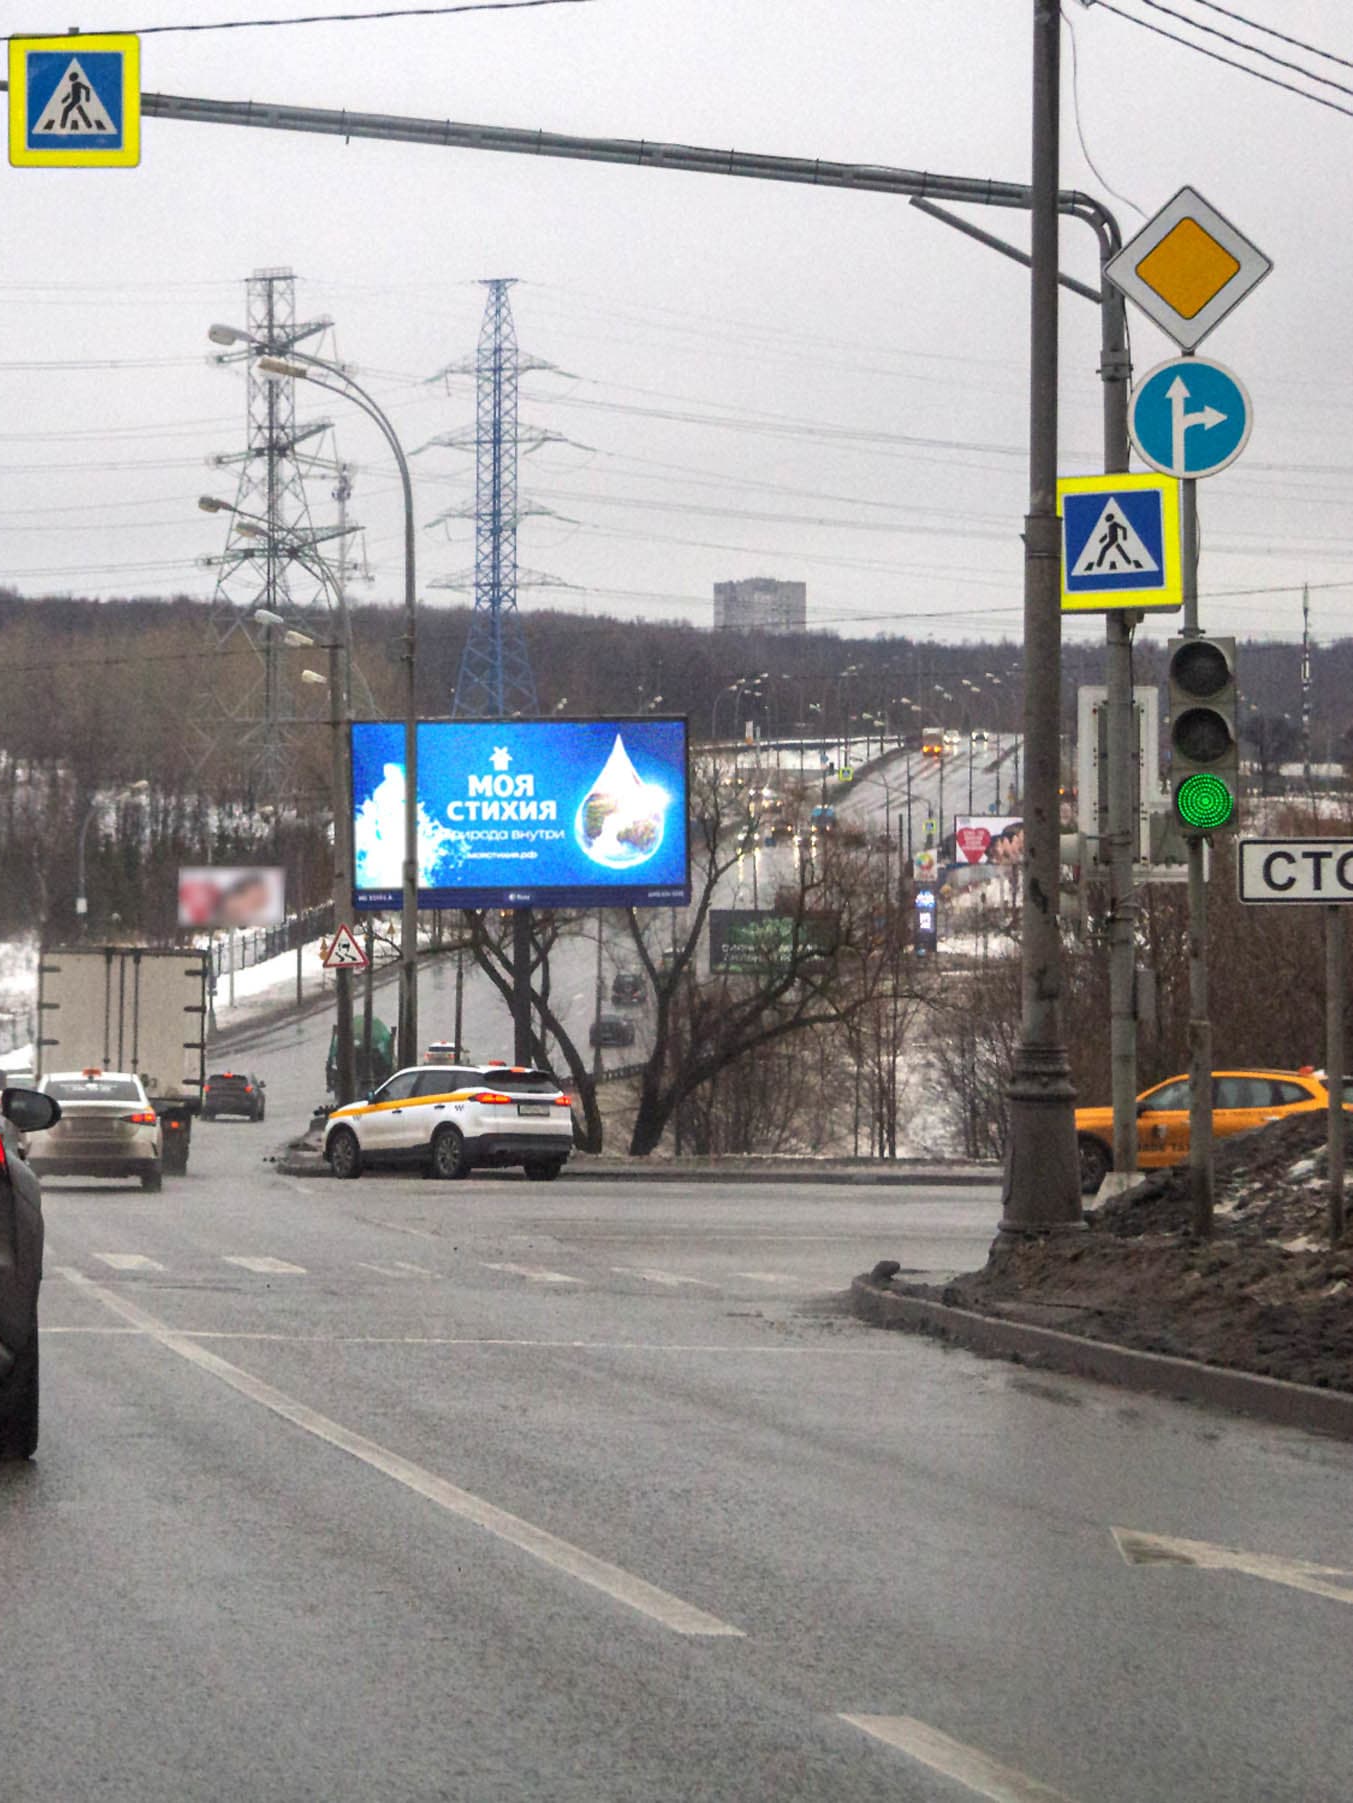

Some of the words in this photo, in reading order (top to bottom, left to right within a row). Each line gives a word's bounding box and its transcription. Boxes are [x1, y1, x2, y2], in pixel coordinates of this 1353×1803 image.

[468, 774, 534, 797] МОЯ
[446, 801, 557, 821] СТИХИЯ
[511, 830, 566, 841] внутри
